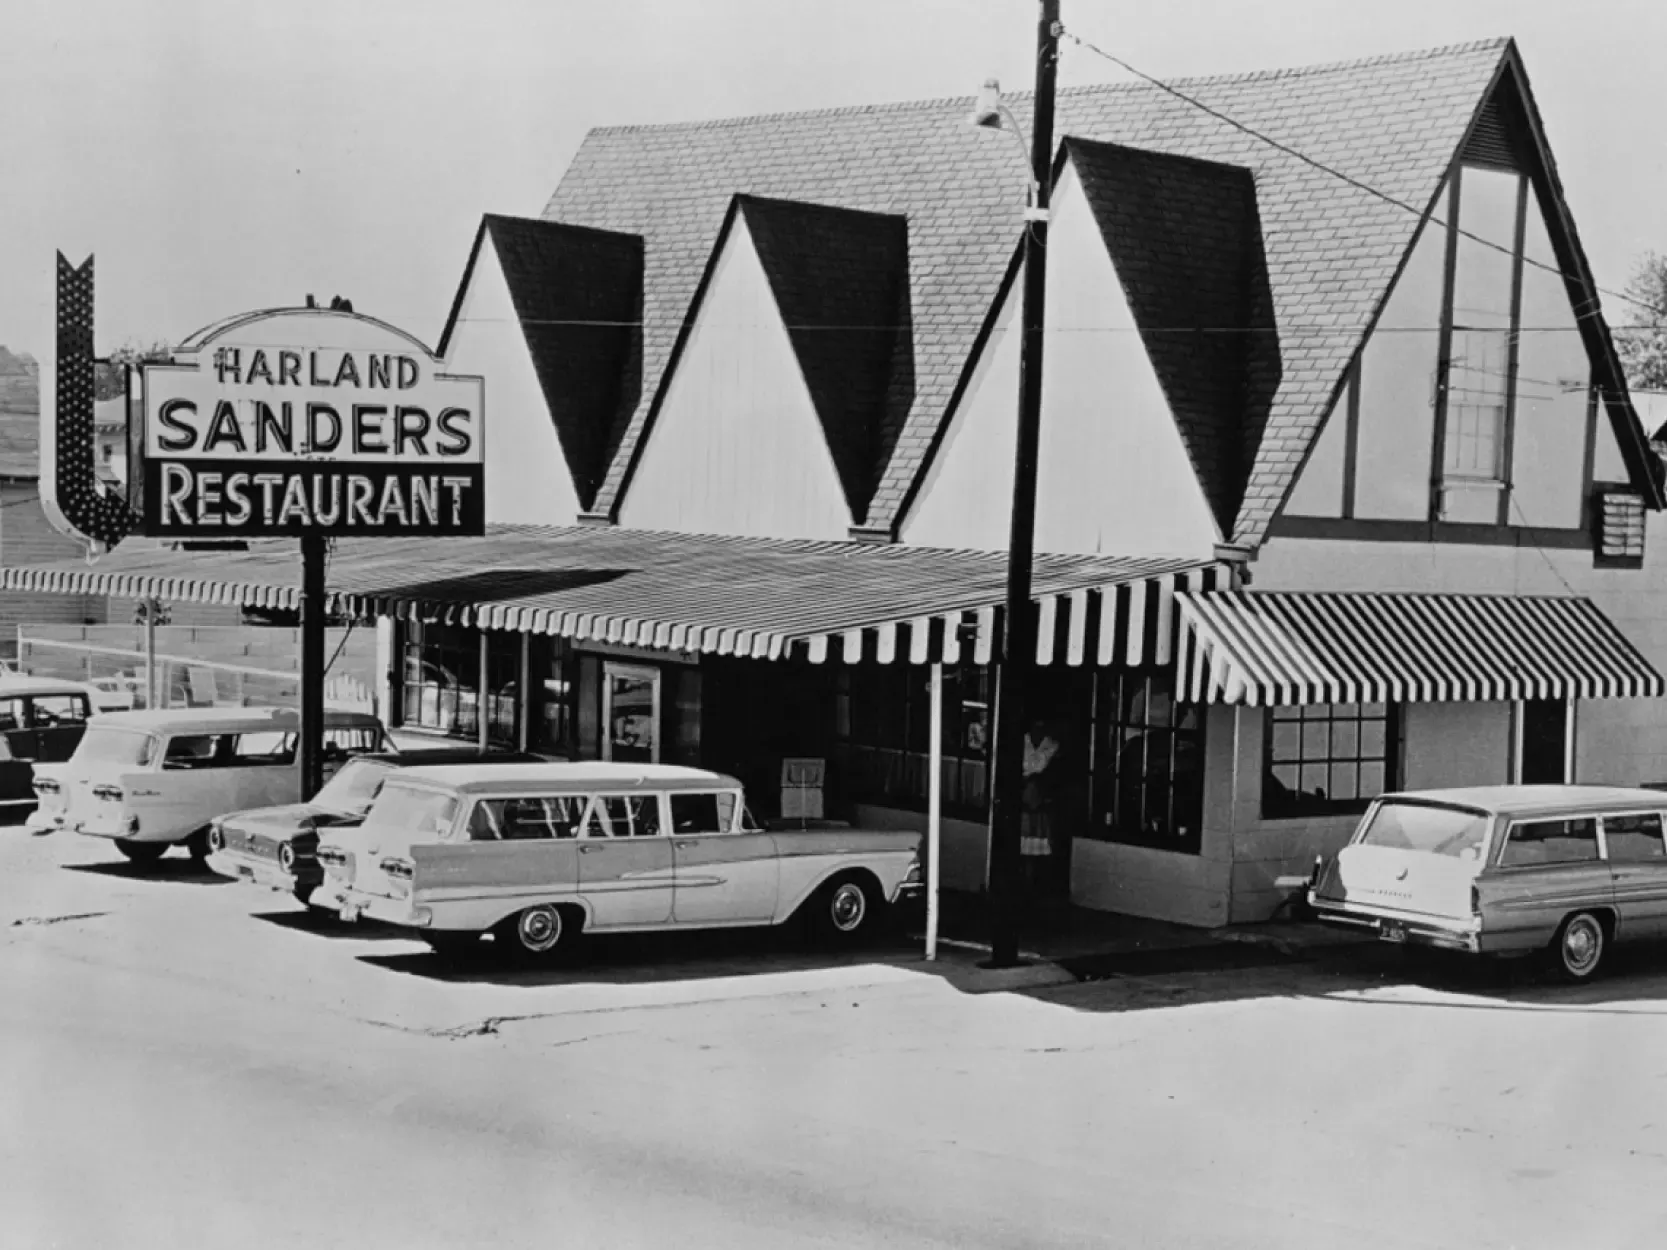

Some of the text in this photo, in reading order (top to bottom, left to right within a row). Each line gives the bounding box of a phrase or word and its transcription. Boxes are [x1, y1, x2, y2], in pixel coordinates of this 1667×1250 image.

[214, 346, 420, 389] HARLAND
[158, 398, 472, 455] SANDERS
[160, 462, 473, 526] RESTAURANT
